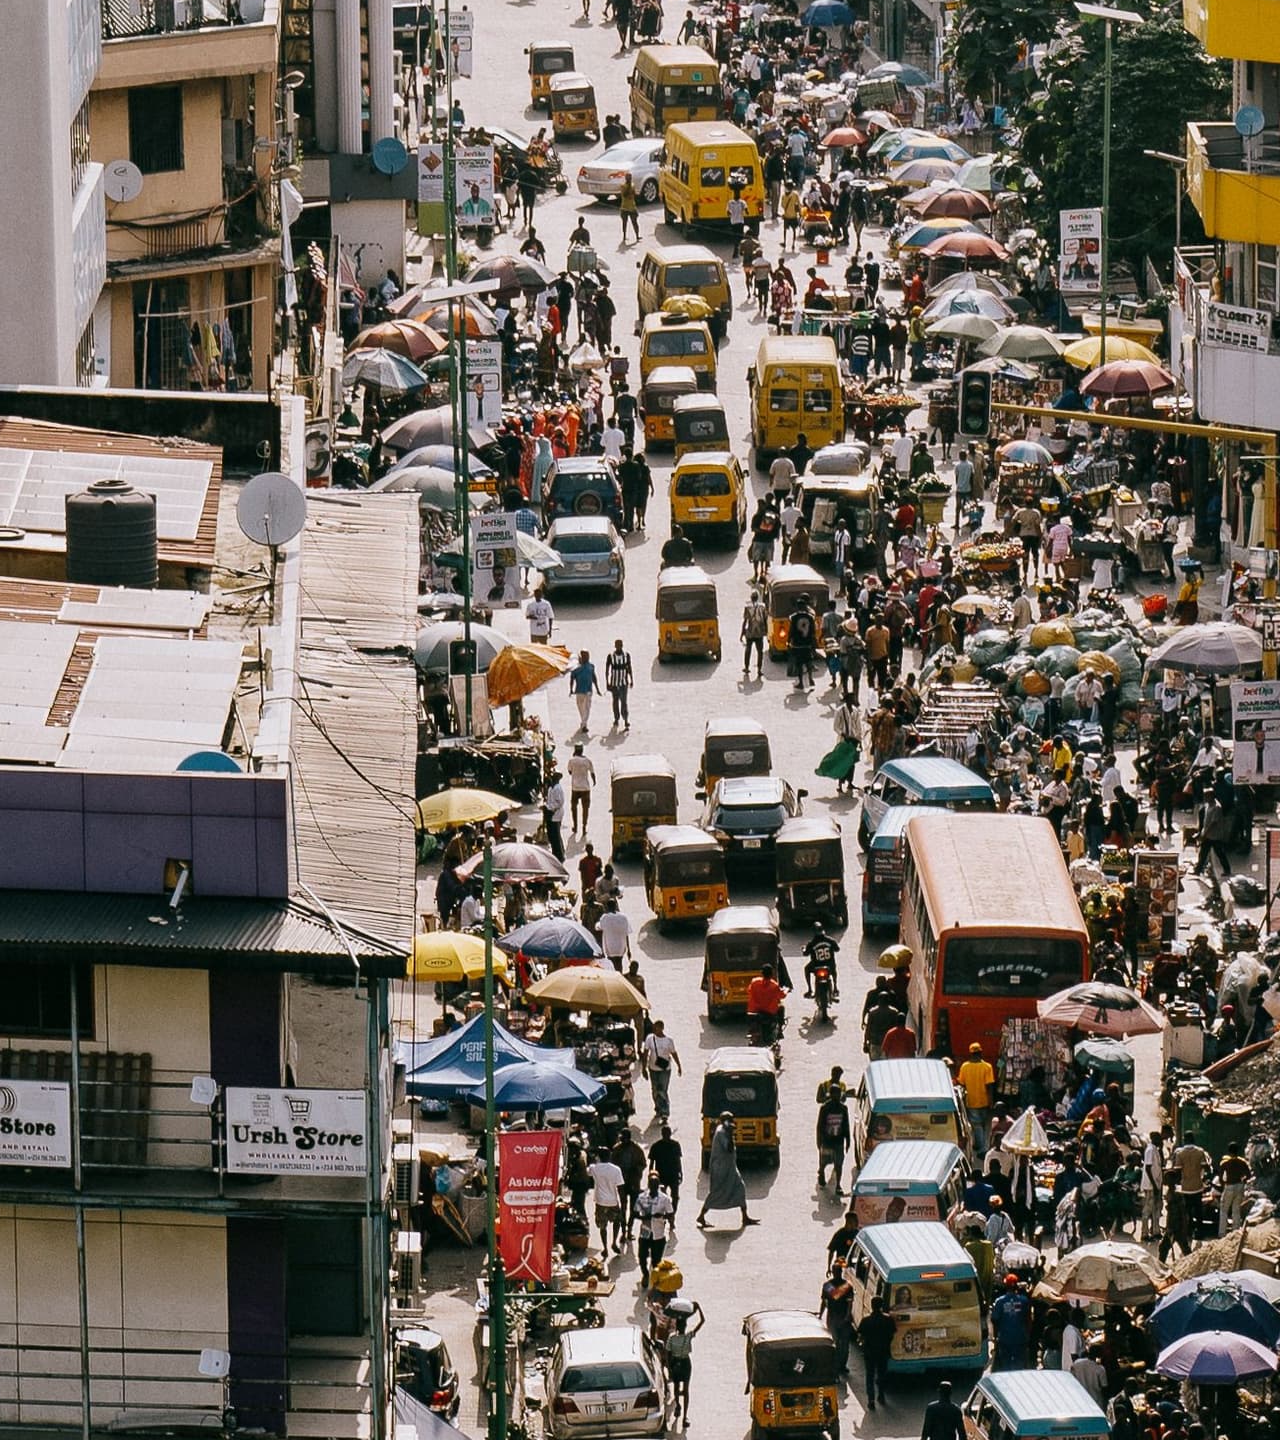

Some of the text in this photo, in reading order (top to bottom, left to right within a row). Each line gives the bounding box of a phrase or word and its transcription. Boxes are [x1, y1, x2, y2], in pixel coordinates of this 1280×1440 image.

[465, 1051, 499, 1062] SALS
[0, 1117, 56, 1137] Store
[232, 1125, 364, 1150] Ursh Store
[248, 1152, 295, 1160] WHOLESALE
[508, 1177, 521, 1187] As
[523, 1177, 542, 1187] low
